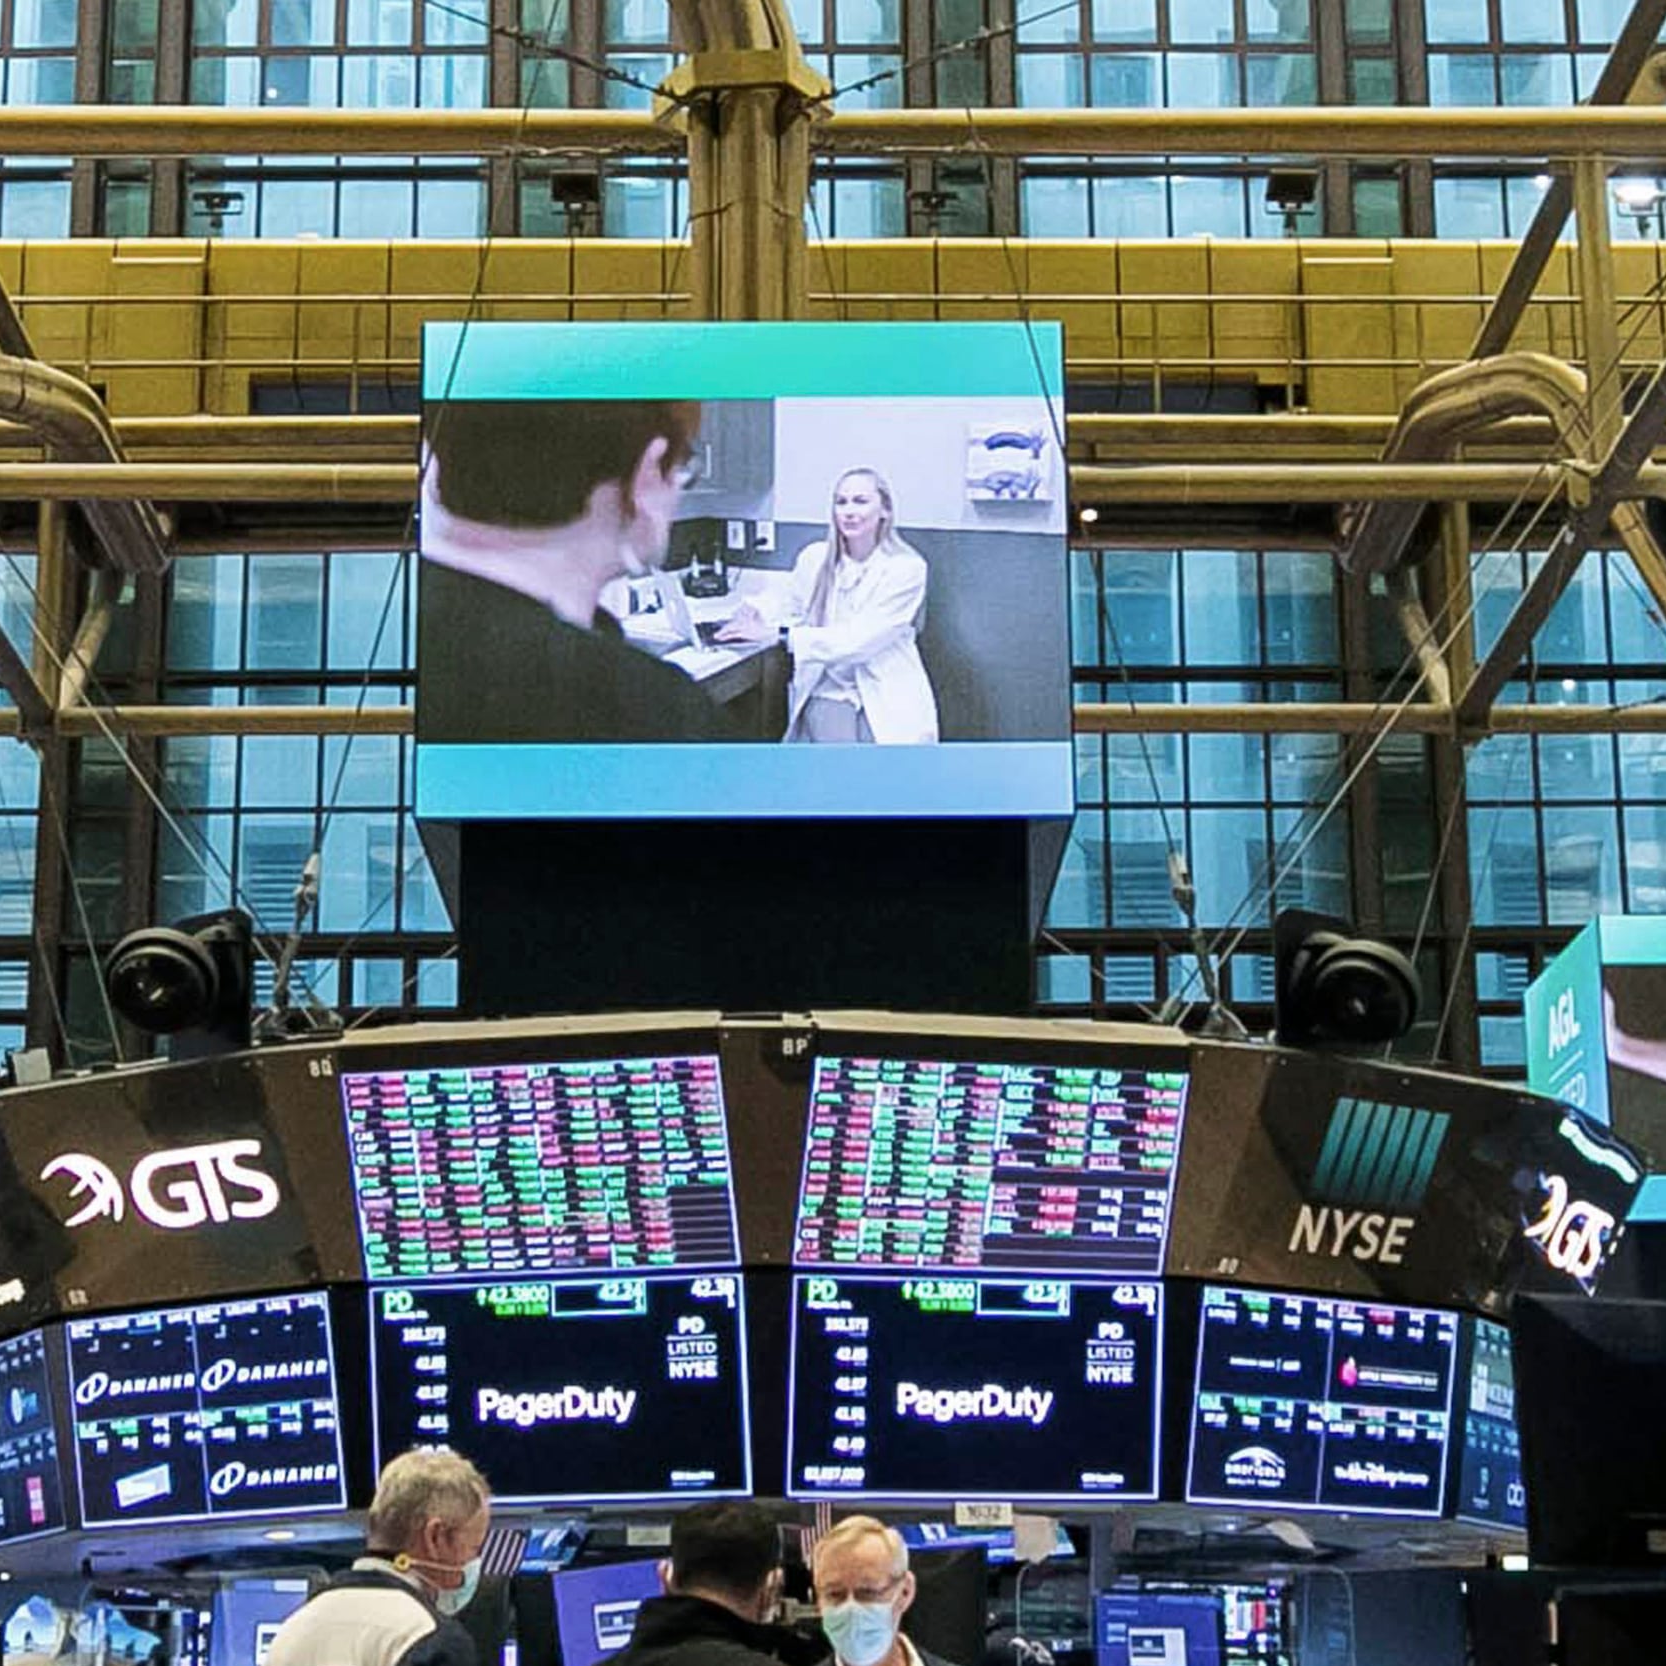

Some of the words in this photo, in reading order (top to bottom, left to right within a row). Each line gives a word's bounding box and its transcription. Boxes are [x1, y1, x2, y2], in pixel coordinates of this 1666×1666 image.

[1547, 987, 1581, 1059] AGL
[131, 1139, 280, 1230] GTS
[1288, 1203, 1414, 1264] NYSE
[383, 1289, 413, 1312] PD
[808, 1279, 838, 1301] PD
[678, 1316, 705, 1335] PD
[1098, 1322, 1124, 1339] PD
[667, 1341, 717, 1357] LISTED
[1086, 1345, 1134, 1360] LISTED
[668, 1361, 718, 1379] NYSE
[1087, 1365, 1134, 1384] NYSE
[478, 1386, 636, 1426] PagerDuty
[896, 1382, 1054, 1424] PagerDuty
